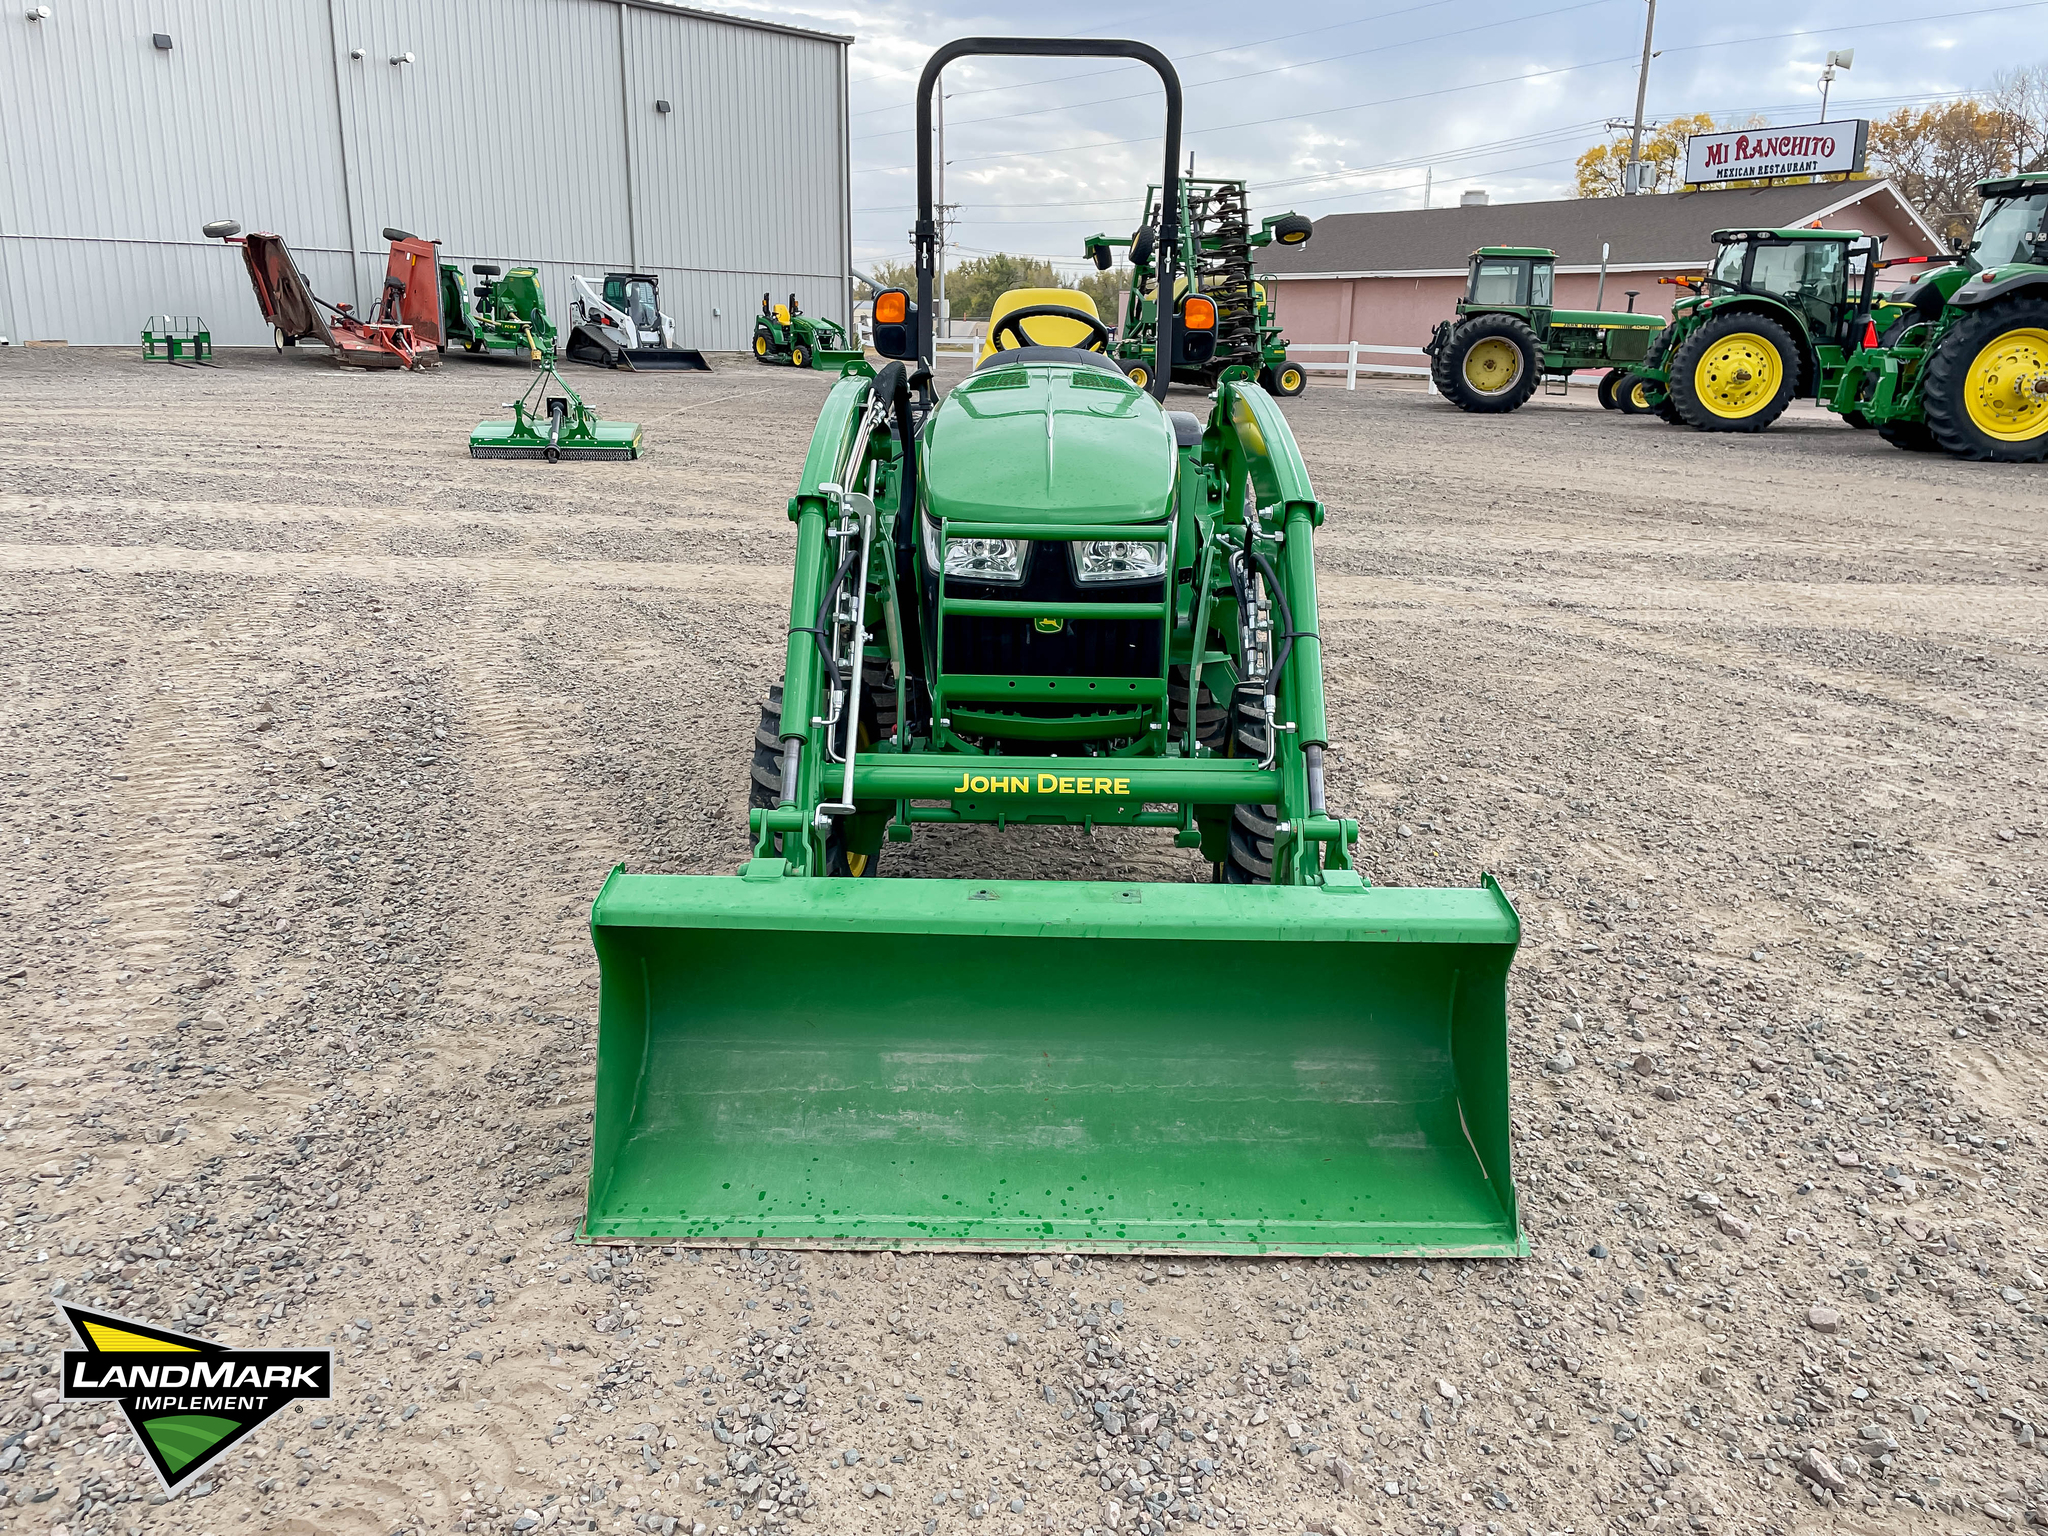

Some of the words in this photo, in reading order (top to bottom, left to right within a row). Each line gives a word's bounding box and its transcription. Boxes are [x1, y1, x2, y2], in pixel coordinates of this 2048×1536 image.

[1705, 143, 1729, 167] MI
[1734, 135, 1836, 161] RANCHITO
[1716, 165, 1755, 179] MEXICAN
[1757, 160, 1819, 175] RESTAURANT
[954, 772, 1030, 794] JOHN
[1037, 773, 1131, 795] DEERE
